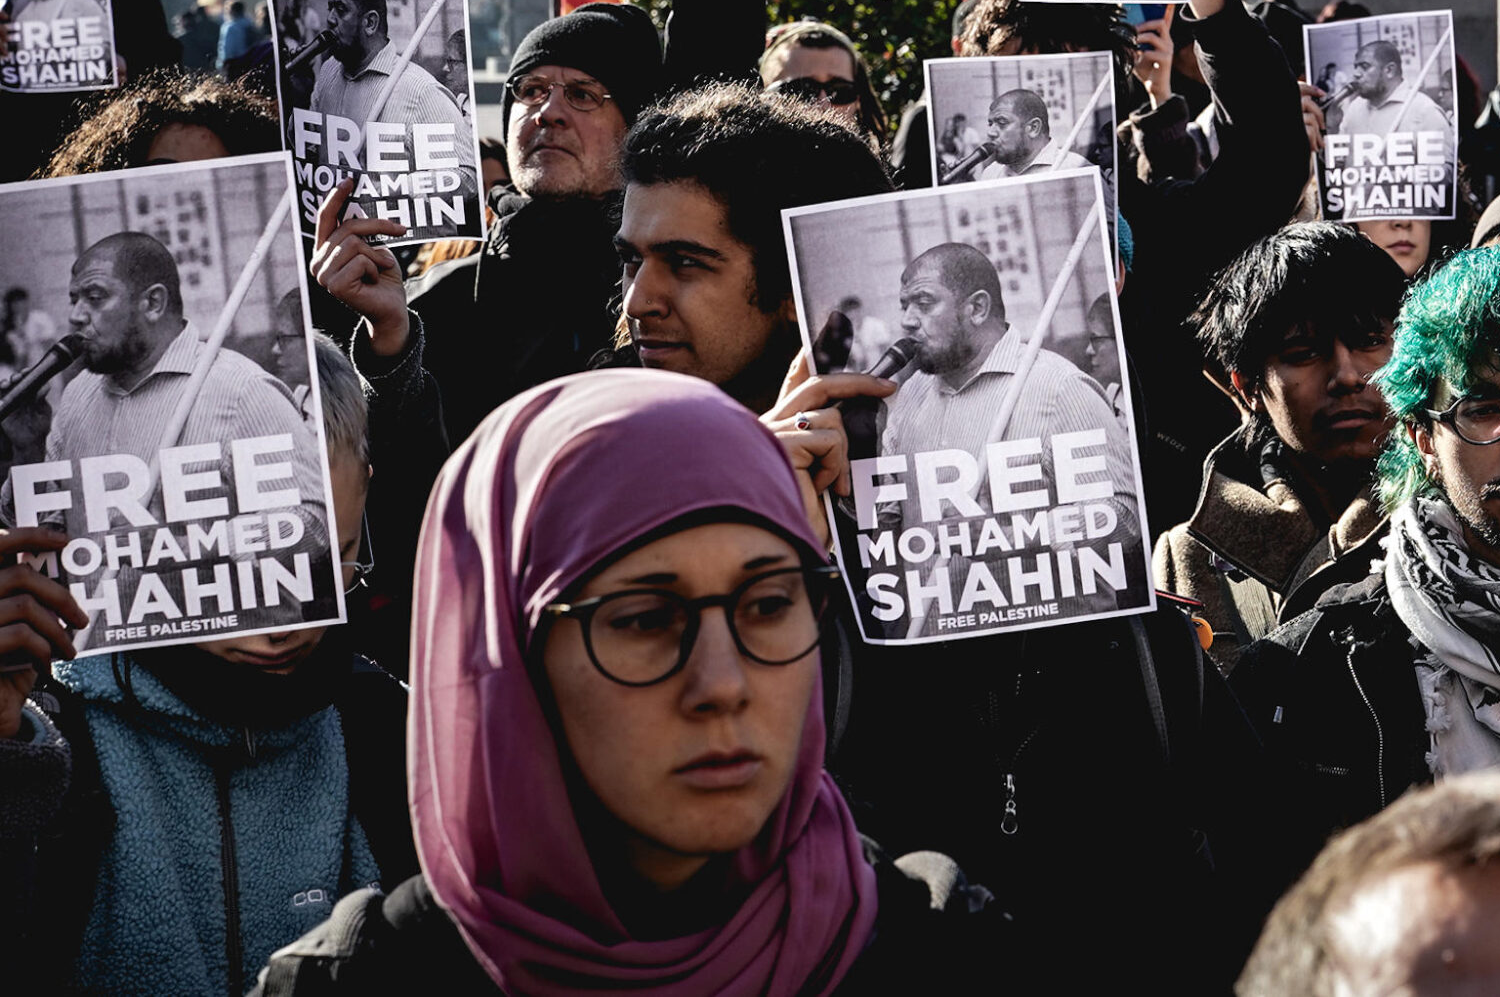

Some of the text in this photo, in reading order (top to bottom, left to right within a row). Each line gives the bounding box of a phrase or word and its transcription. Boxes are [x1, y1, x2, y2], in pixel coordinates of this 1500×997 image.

[2, 60, 106, 84] SHAHIN
[293, 108, 460, 172] FREE
[1324, 131, 1445, 169] FREE
[1325, 165, 1445, 187] MOHAMED
[302, 190, 466, 228] SAHIN
[1327, 184, 1446, 212] SHAHIN
[11, 433, 302, 533] FREE
[851, 429, 1114, 530] FREE
[857, 504, 1118, 569] MOHAMED
[68, 553, 314, 627] HAHIN
[866, 543, 1128, 622] SHAHIN
[105, 614, 239, 642] FREE PALESTINE
[938, 603, 1059, 630] FREE PALESTINE
